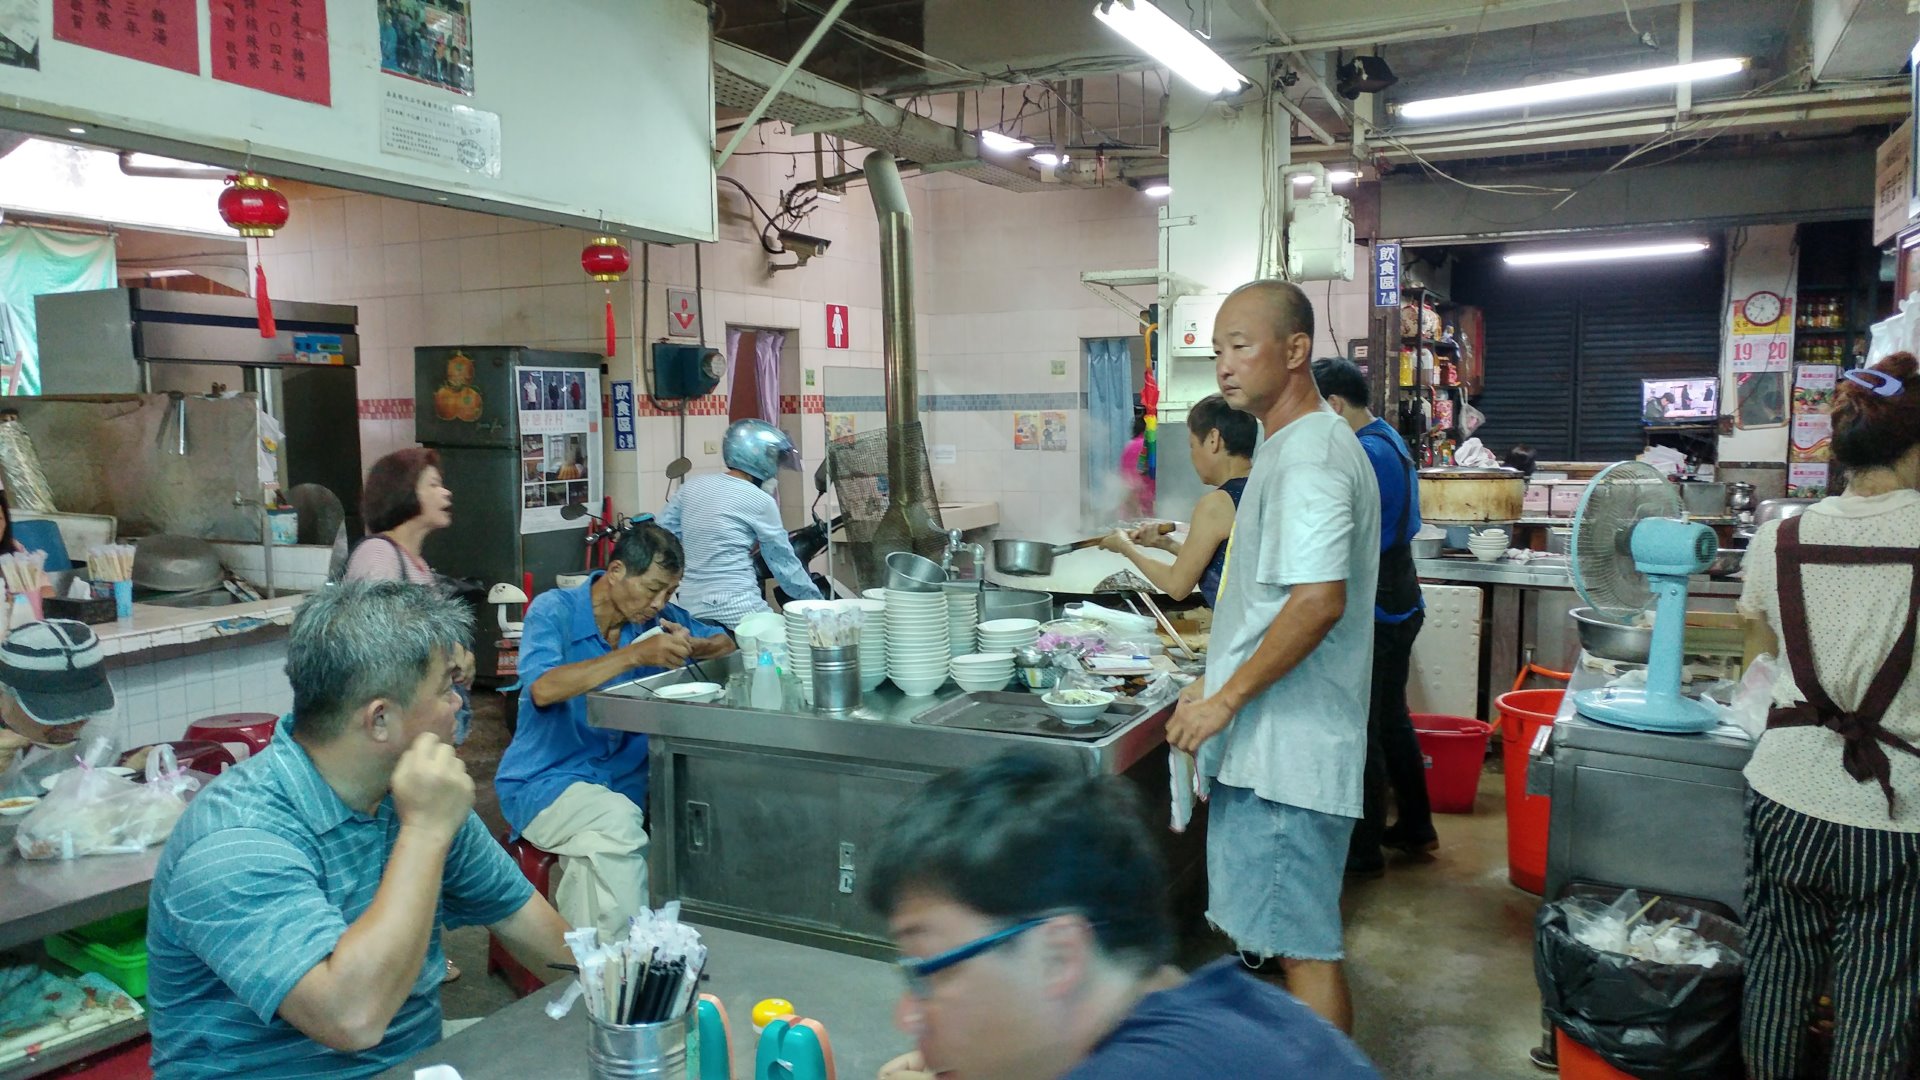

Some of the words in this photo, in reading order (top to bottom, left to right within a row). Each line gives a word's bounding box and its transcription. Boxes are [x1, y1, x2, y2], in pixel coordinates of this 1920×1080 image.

[1379, 246, 1396, 290] 飲食區
[1733, 342, 1753, 361] 19
[1768, 341, 1787, 360] 20
[614, 384, 632, 432] 飲食區
